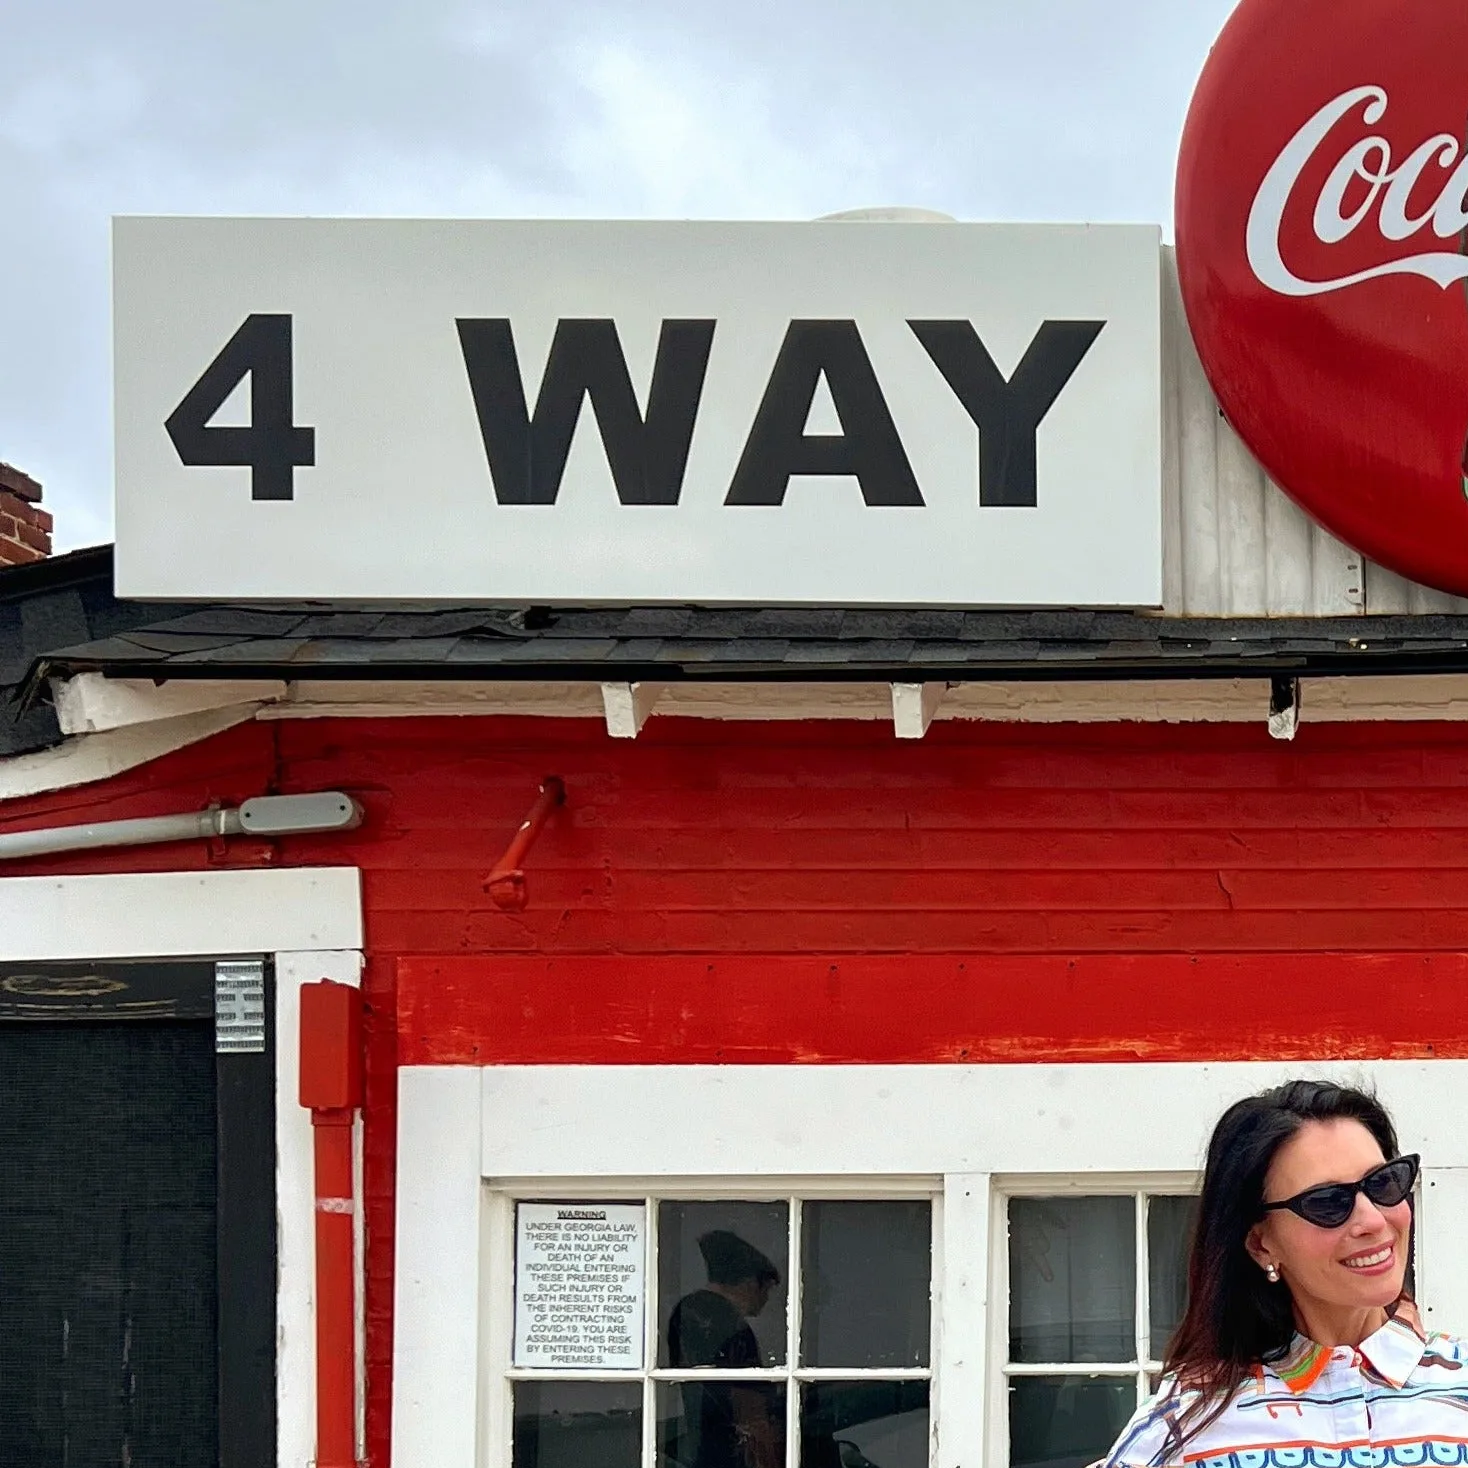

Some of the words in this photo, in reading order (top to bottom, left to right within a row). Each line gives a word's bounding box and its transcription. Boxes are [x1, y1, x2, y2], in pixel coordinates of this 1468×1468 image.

[164, 313, 316, 502] 4
[455, 318, 1108, 508] WAY
[557, 1210, 606, 1220] WARNING
[526, 1223, 561, 1231] UNDER
[565, 1223, 611, 1231] GEORGIA
[526, 1233, 558, 1241] THERE
[562, 1233, 571, 1241] IS
[574, 1233, 589, 1241] NO
[592, 1234, 637, 1242] LIABILITY
[534, 1243, 555, 1251] FOR
[558, 1243, 571, 1251] AN
[575, 1243, 609, 1252] INJURY
[613, 1244, 628, 1252] OR
[548, 1253, 580, 1261] DEATH
[584, 1253, 597, 1261] OF
[600, 1254, 614, 1262] AN
[526, 1263, 580, 1271] INDIVIDUAL
[584, 1264, 636, 1272] ENTERING
[531, 1273, 563, 1282] THESE
[567, 1274, 618, 1282] PREMISES
[538, 1284, 566, 1292] SUCH
[569, 1284, 605, 1292] INJURY
[608, 1284, 622, 1292] OR
[523, 1294, 556, 1302] DEATH
[560, 1294, 605, 1303] RESULTS
[608, 1295, 636, 1303] FROM
[527, 1304, 546, 1312] THE
[550, 1304, 599, 1313] INHERENT
[603, 1305, 633, 1313] RISKS
[534, 1314, 547, 1322] OF
[551, 1314, 624, 1323] CONTRACTING
[583, 1325, 604, 1333] YOU
[606, 1325, 627, 1333] ARE
[527, 1334, 580, 1343] ASSUMING
[584, 1335, 605, 1343] THIS
[608, 1336, 632, 1344] RISK
[543, 1345, 594, 1353] ENTERING
[598, 1346, 630, 1354] THESE
[551, 1355, 605, 1363] PREMISES.
